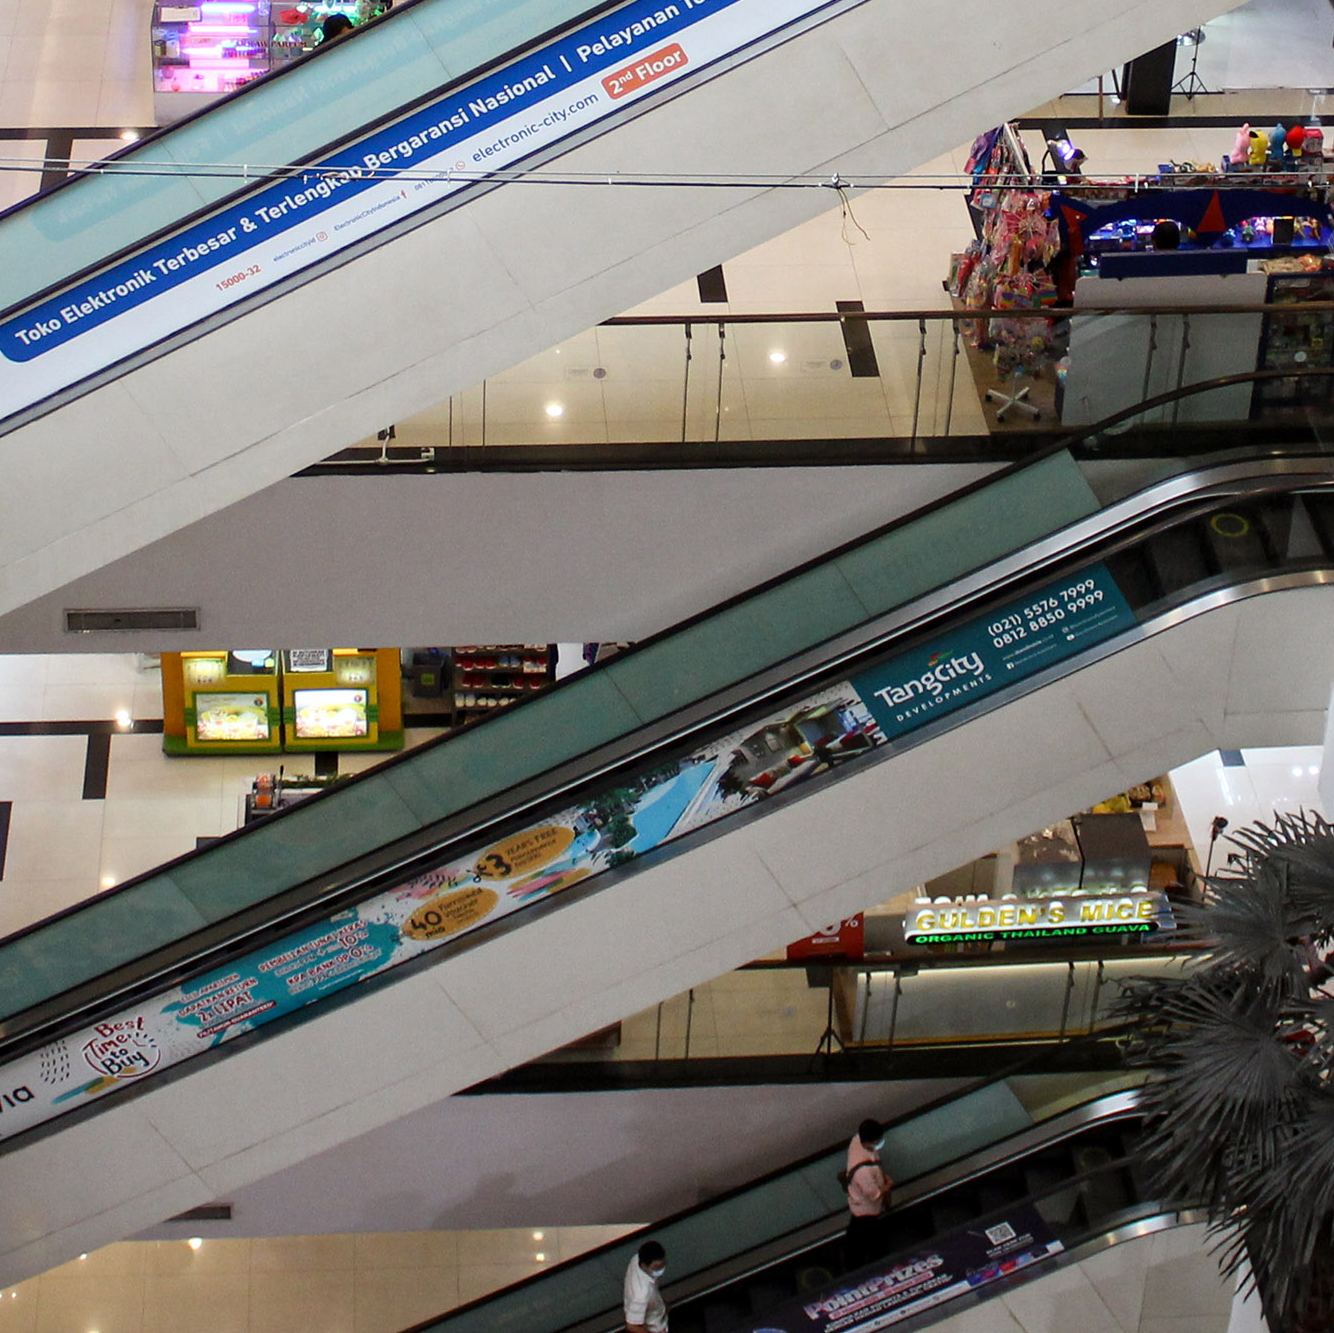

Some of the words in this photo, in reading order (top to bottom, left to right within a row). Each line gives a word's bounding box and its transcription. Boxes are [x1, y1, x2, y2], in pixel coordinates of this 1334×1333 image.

[607, 69, 635, 95] 2nd
[634, 47, 684, 82] Floor
[14, 316, 62, 348] Toko
[60, 270, 157, 326] Elektronik
[152, 224, 239, 277] Terbesar
[240, 215, 258, 234] &
[255, 165, 364, 226] Terlengkap
[362, 106, 470, 171] Bergaransi
[467, 63, 558, 119] Nasional
[576, 2, 681, 65] Pelayanan
[215, 264, 262, 293] 15000-32
[470, 90, 599, 164] electronic-city.com
[987, 613, 1022, 637] (021)
[1023, 597, 1058, 619] 5576
[1059, 578, 1095, 602] 7999
[993, 626, 1027, 648] 0812
[1029, 608, 1065, 632] 8850
[1067, 589, 1104, 613] 9999
[873, 651, 985, 707] TangCity
[896, 673, 992, 722] DEVELOPMENTS
[485, 853, 512, 875] 3
[534, 827, 558, 843] FREE
[410, 910, 442, 931] 40
[915, 932, 995, 944] ORGANIC
[1000, 926, 1087, 939] THAILAND
[1092, 923, 1150, 934] GUAVA
[258, 945, 309, 972] PEMBELIAN
[308, 958, 336, 978] BANK
[82, 1032, 128, 1060] Time
[94, 1016, 145, 1038] Best
[101, 1050, 150, 1076] Buy
[110, 1047, 129, 1060] to
